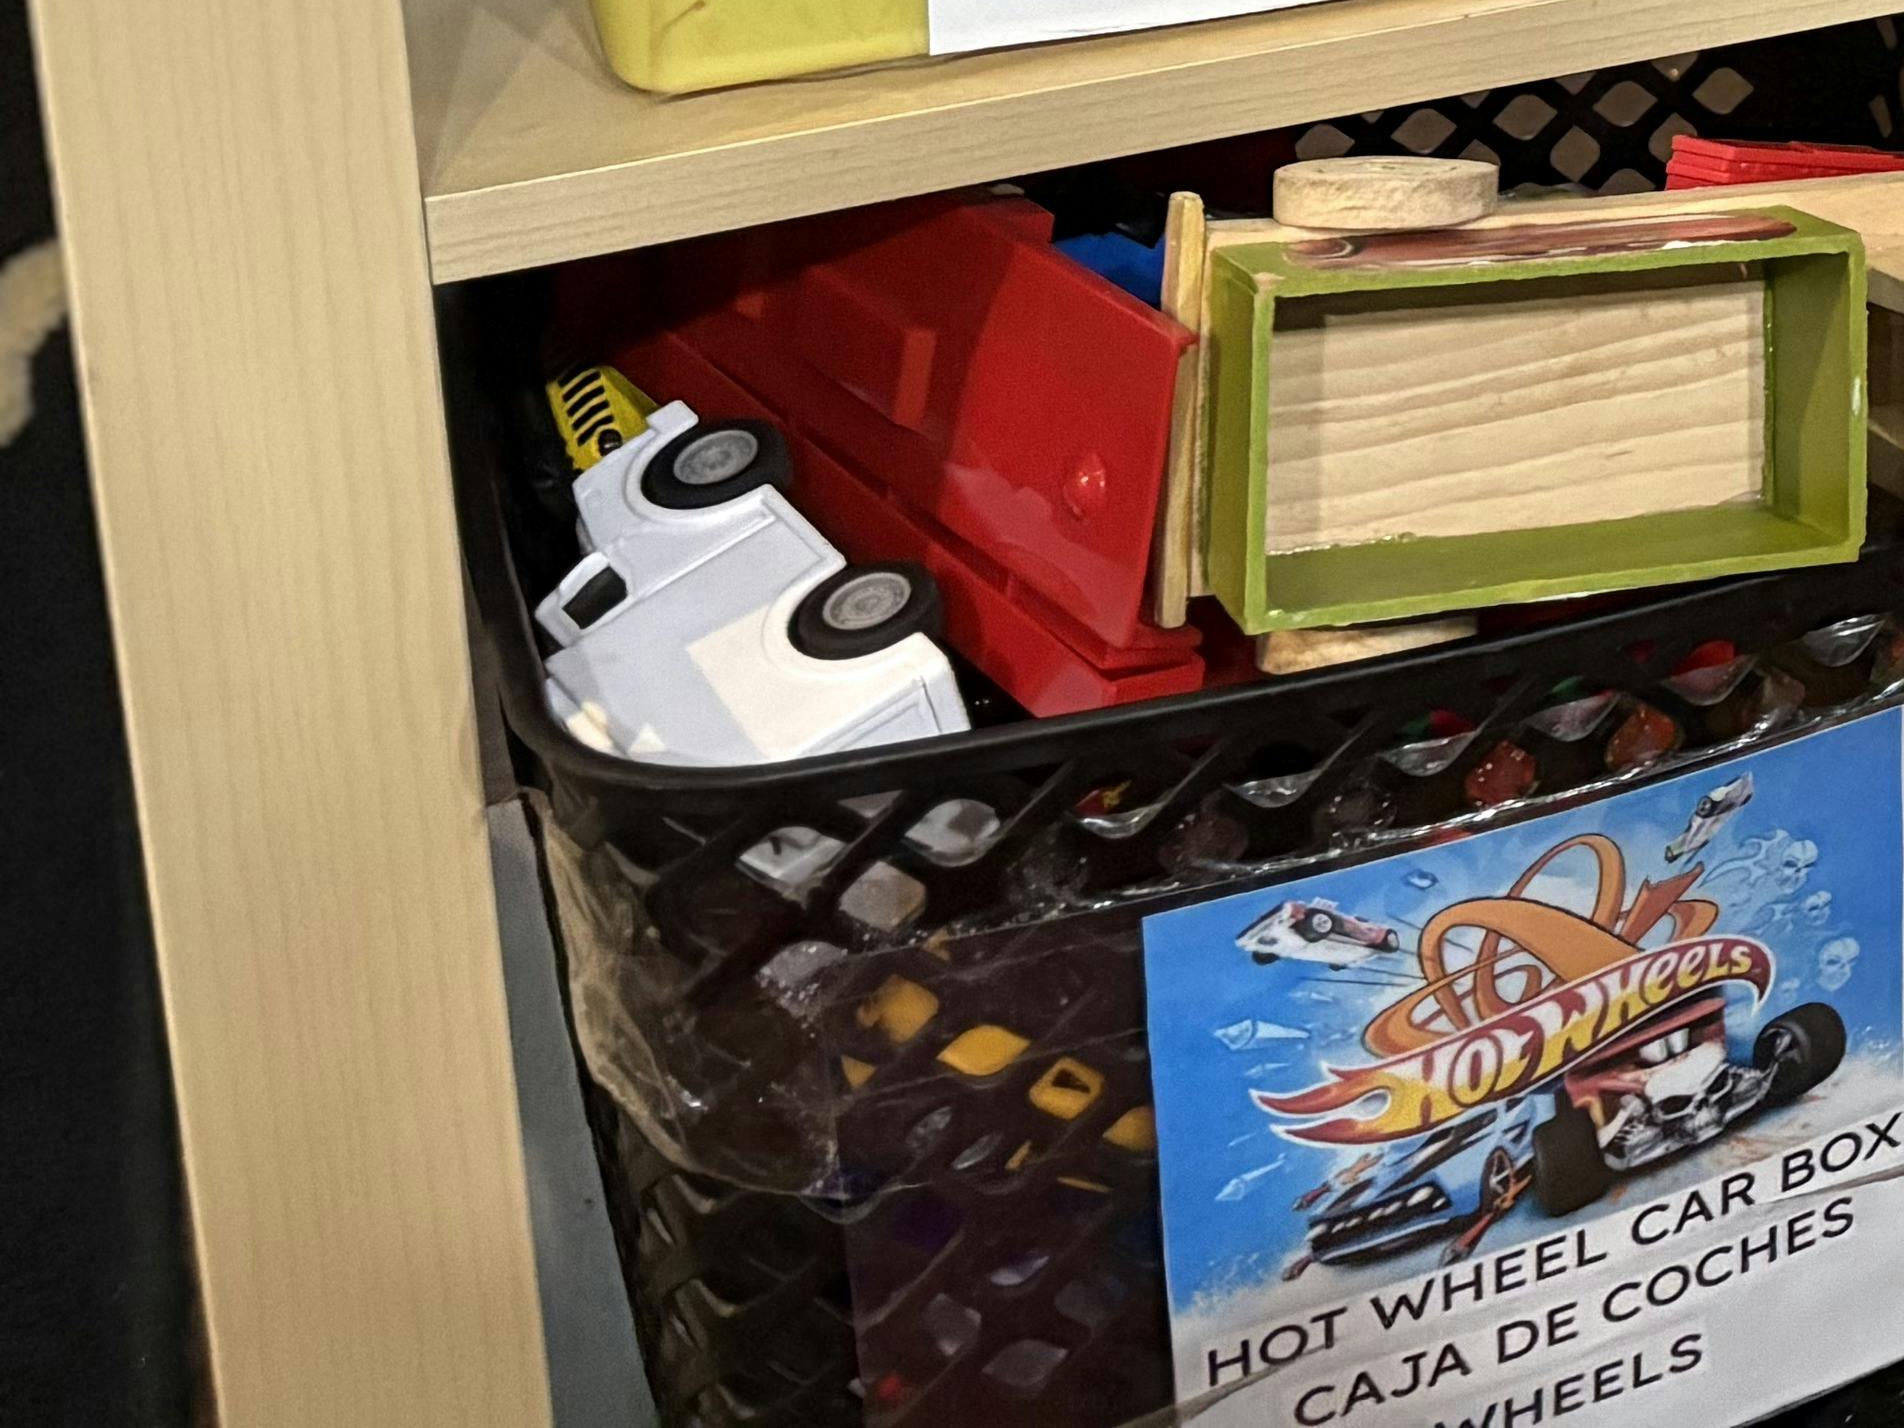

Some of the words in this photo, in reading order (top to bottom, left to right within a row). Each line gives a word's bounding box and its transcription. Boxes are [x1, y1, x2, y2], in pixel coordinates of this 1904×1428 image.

[1393, 1022, 1540, 1130] HOT
[1207, 1307, 1348, 1388] HOT
[1371, 1229, 1608, 1330] WHEEL
[1632, 1172, 1756, 1245] CAR
[1780, 1111, 1904, 1194] BOX
[1293, 1343, 1472, 1428] CAJA
[1495, 1301, 1580, 1367] DE
[1602, 1195, 1856, 1324] COCHES
